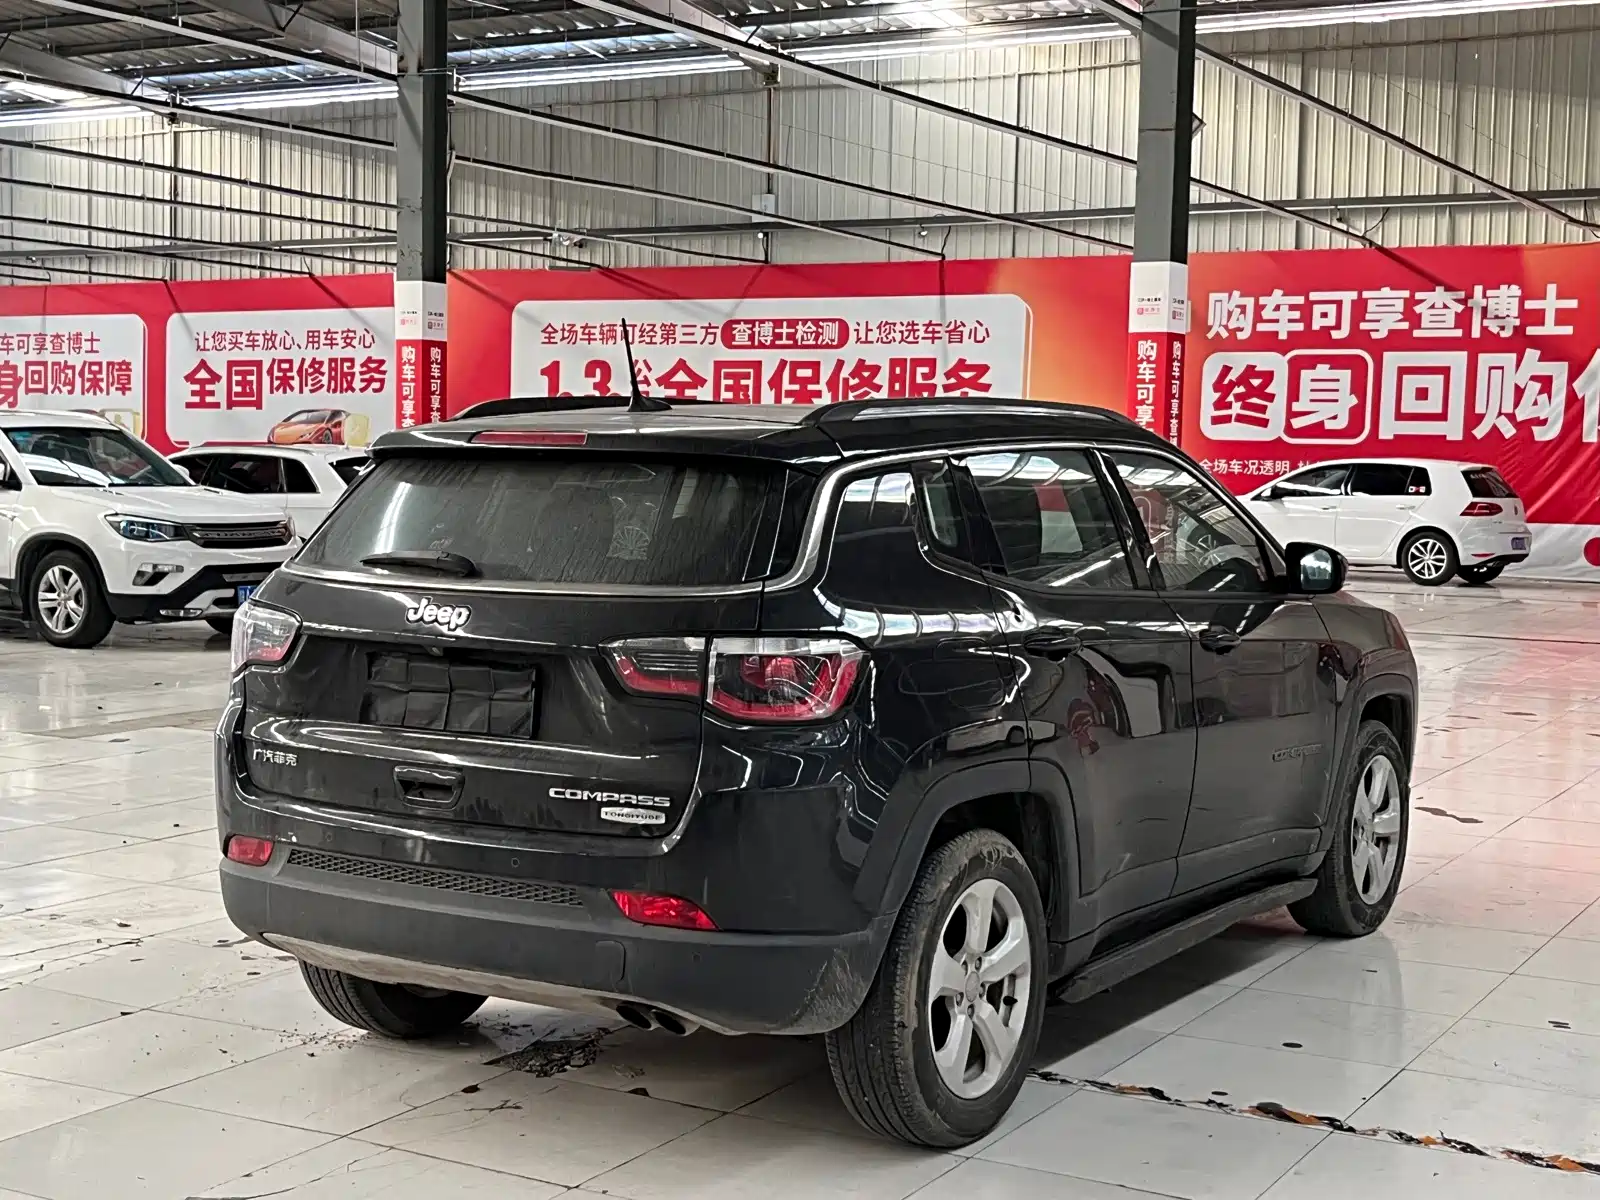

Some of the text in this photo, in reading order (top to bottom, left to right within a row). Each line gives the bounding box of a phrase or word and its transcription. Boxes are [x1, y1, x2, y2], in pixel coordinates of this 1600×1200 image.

[1206, 283, 1579, 340] 购车可享查博士
[0, 331, 101, 355] 车可享查博士
[194, 327, 376, 352] 让您买车放心、用车安心
[540, 319, 991, 347] 全场车辆可经第三方 查博士检测 让您选车省心
[183, 355, 388, 411] 全国保修服务
[1135, 339, 1157, 432] 购车可享
[1199, 458, 1290, 476] 全场车况透明
[406, 597, 471, 630] Jeep
[252, 748, 298, 767] 广汽菲克
[548, 787, 670, 807] COMPASS
